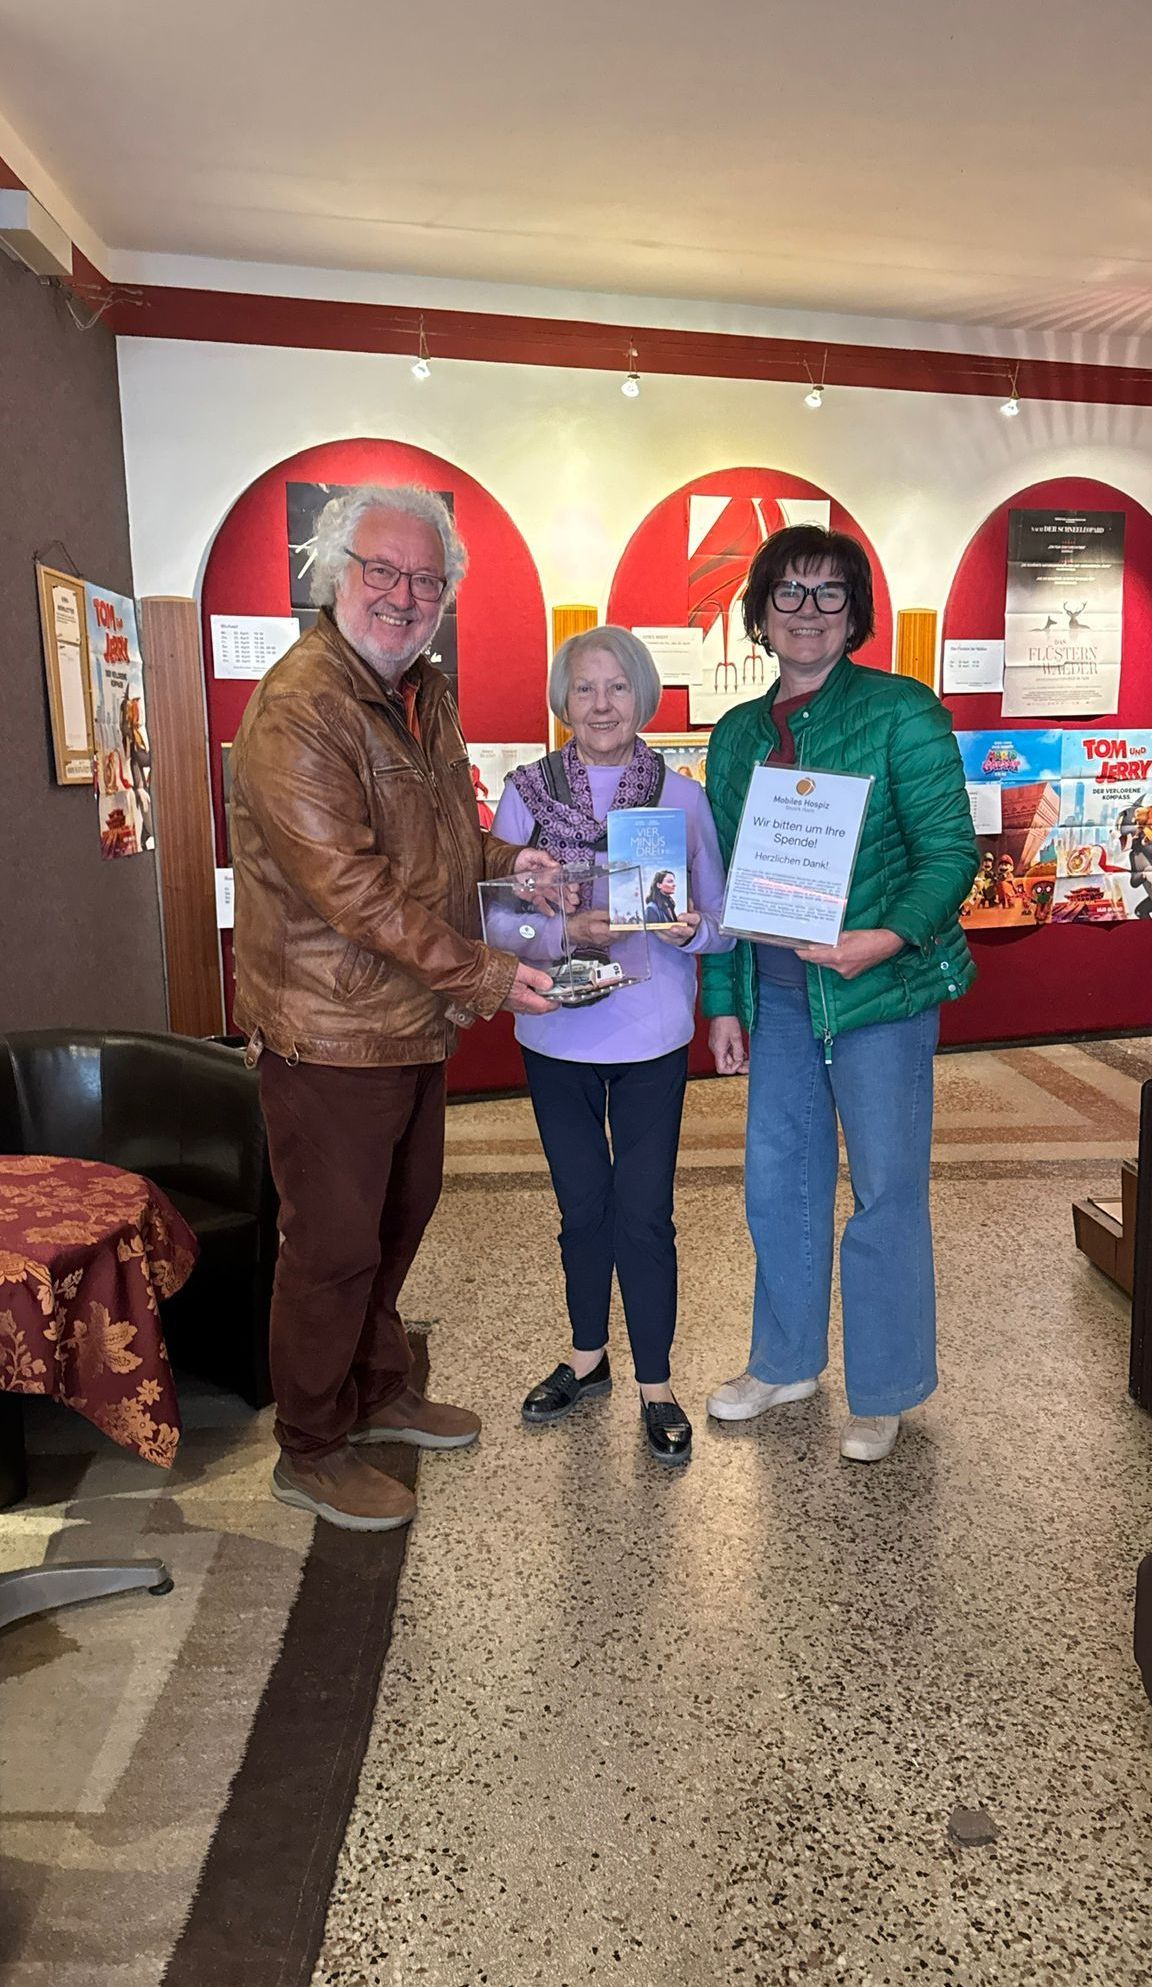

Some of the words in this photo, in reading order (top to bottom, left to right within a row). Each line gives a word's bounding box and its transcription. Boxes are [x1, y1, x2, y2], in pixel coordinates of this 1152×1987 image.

[93, 598, 117, 631] TOM
[1028, 645, 1098, 661] FLÜSTERN
[1083, 739, 1127, 759] TOM
[1129, 747, 1147, 756] UND
[1095, 760, 1152, 783] JERRY
[773, 795, 802, 806] Mobiles
[803, 799, 830, 810] Hospiz
[637, 827, 660, 837] VIER
[753, 816, 770, 827] Wir
[772, 819, 803, 831] bitten
[805, 825, 822, 834] um
[825, 826, 846, 838] Ihre
[630, 836, 666, 847] MINUS
[773, 833, 818, 848] Spende!
[635, 847, 661, 857] DREI
[754, 851, 801, 865] Herzlichen
[802, 858, 829, 870] Dank!
